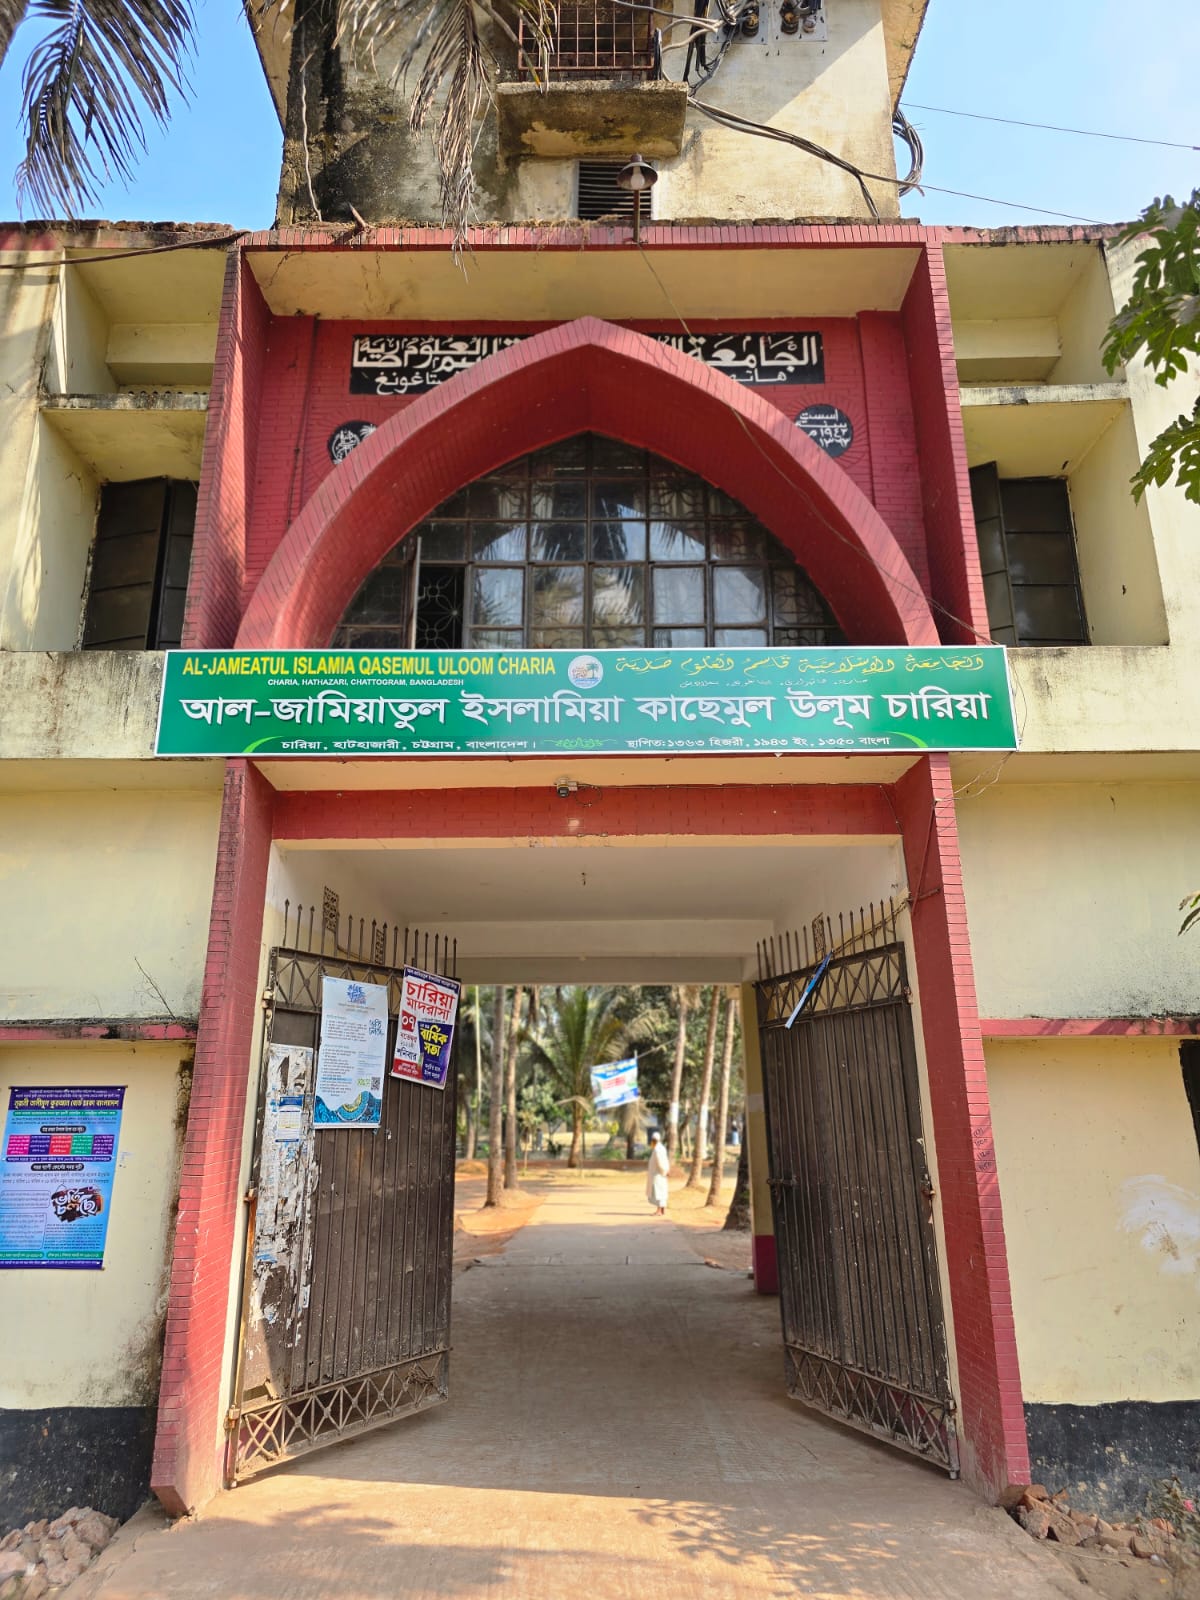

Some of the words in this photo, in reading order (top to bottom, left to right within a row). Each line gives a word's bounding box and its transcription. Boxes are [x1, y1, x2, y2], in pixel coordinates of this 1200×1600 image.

[182, 657, 290, 675] AL-JAMEATUL
[293, 656, 355, 675] ISLAMIA
[358, 656, 434, 675] QASEMUL
[438, 656, 494, 675] ULOOM
[498, 656, 556, 675] CHARIA
[301, 678, 349, 686] HATHAZARI,
[350, 678, 408, 686] CHATTOGRAM,
[409, 678, 464, 686] BANGLADESH
[179, 689, 450, 733] আল-জামিয়াতুল
[458, 689, 625, 726] ইসলামিয়া
[633, 694, 776, 727] কাছেমুল
[784, 687, 874, 729] উলূম
[881, 685, 992, 720] চারিয়া
[858, 736, 891, 746] বাংলা
[406, 980, 456, 1010] চারিয়া
[406, 997, 451, 1021] মাদরাসা
[401, 1015, 416, 1031] ০৭
